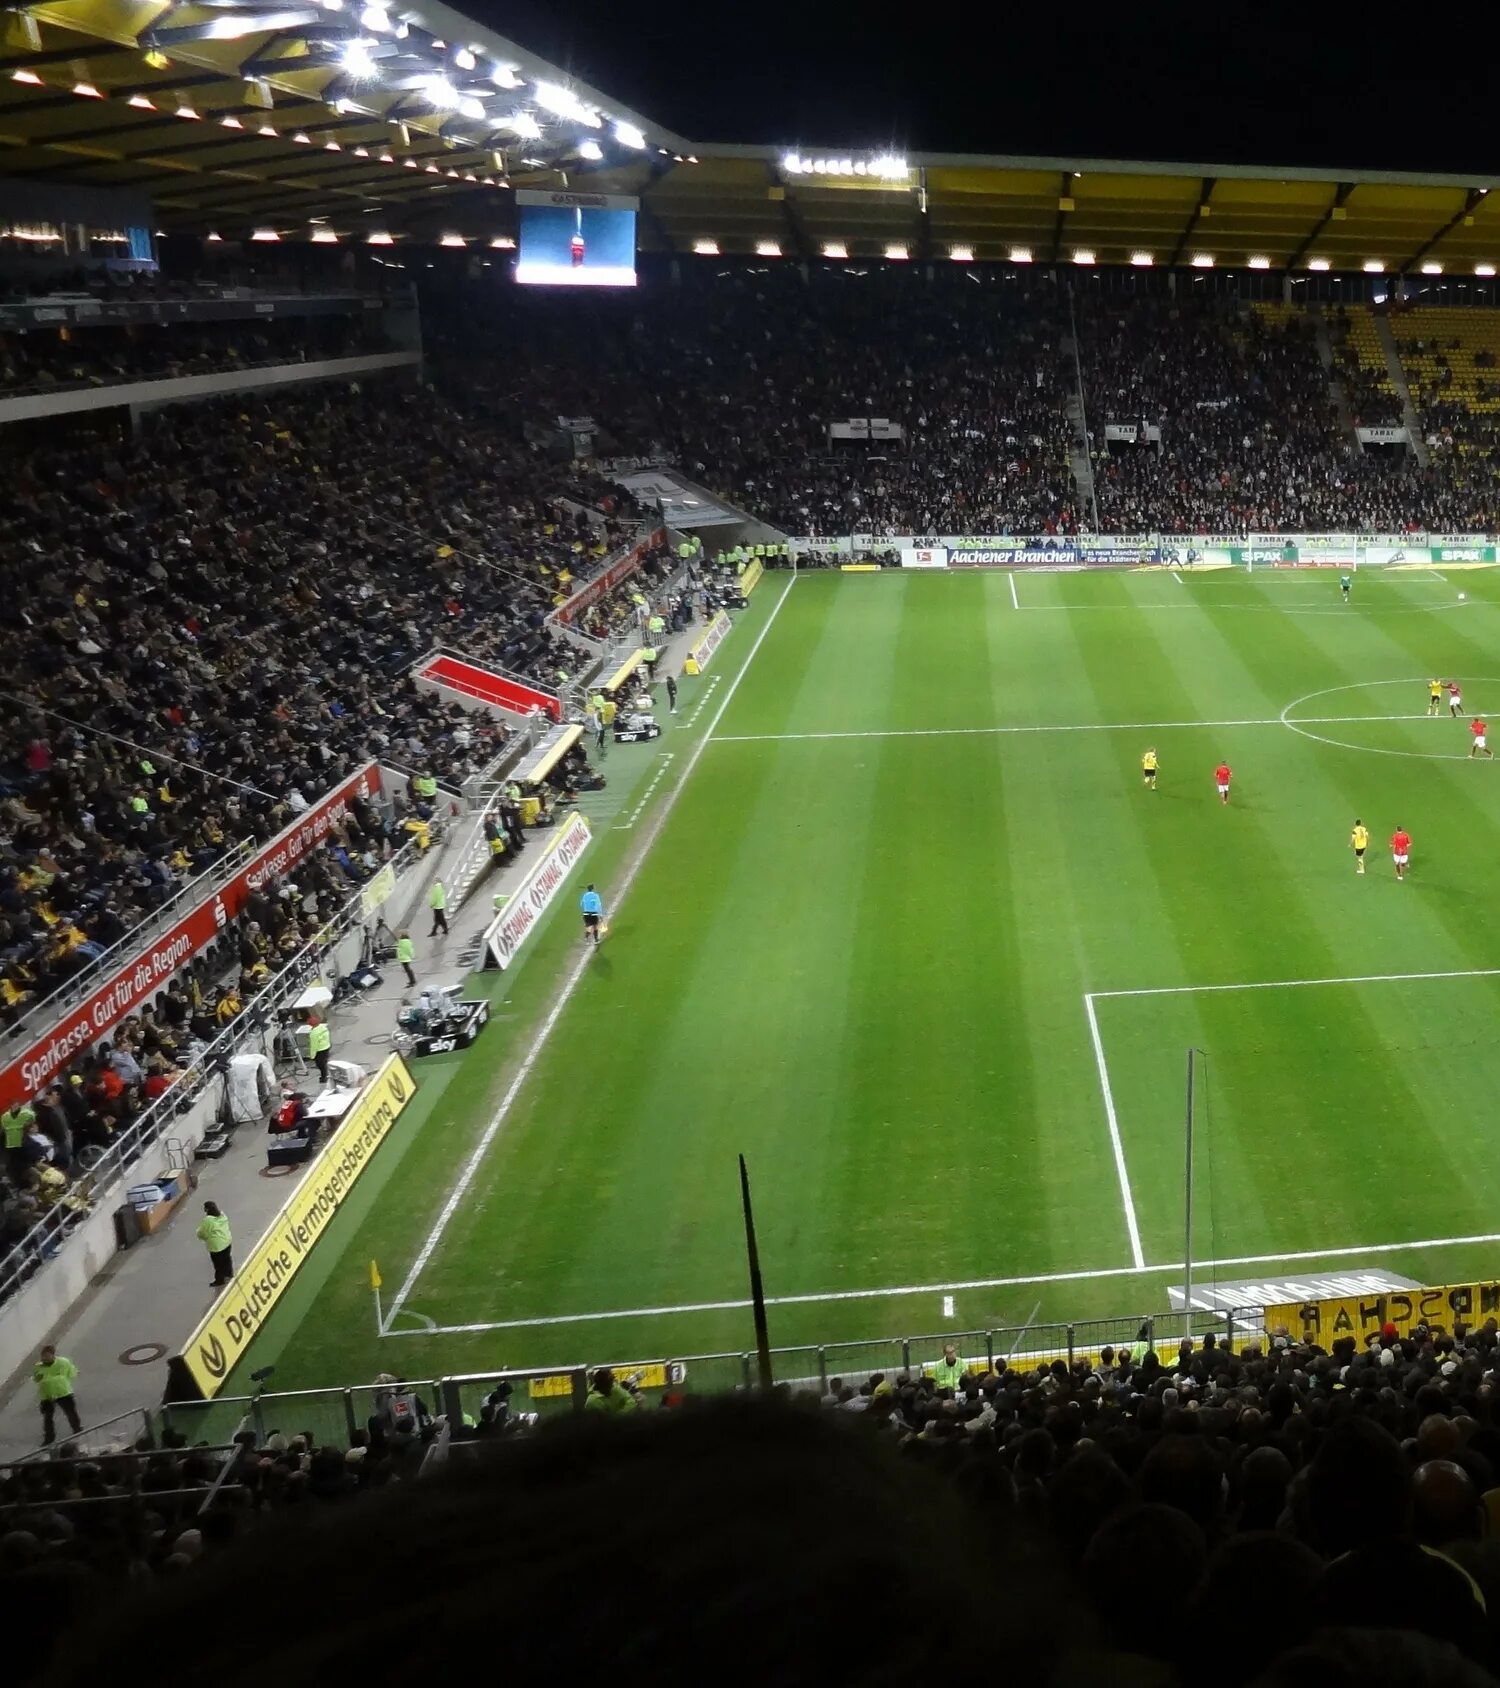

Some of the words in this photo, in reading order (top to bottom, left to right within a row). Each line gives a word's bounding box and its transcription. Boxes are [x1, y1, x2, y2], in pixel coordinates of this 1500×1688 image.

[950, 550, 1009, 563] Aachener
[1014, 550, 1075, 563] Branchen
[1241, 551, 1282, 562] SPAX
[1441, 550, 1481, 562] SPAX
[503, 901, 534, 949] STAWAG
[21, 1020, 94, 1092] Sparkasse.
[92, 996, 119, 1028] Gut
[114, 982, 136, 1013] für
[134, 965, 153, 993] die
[152, 933, 194, 976] Region.
[430, 1039, 457, 1053] sky
[225, 1250, 293, 1346] Deutsche
[286, 1099, 394, 1254] Vermögensberatung
